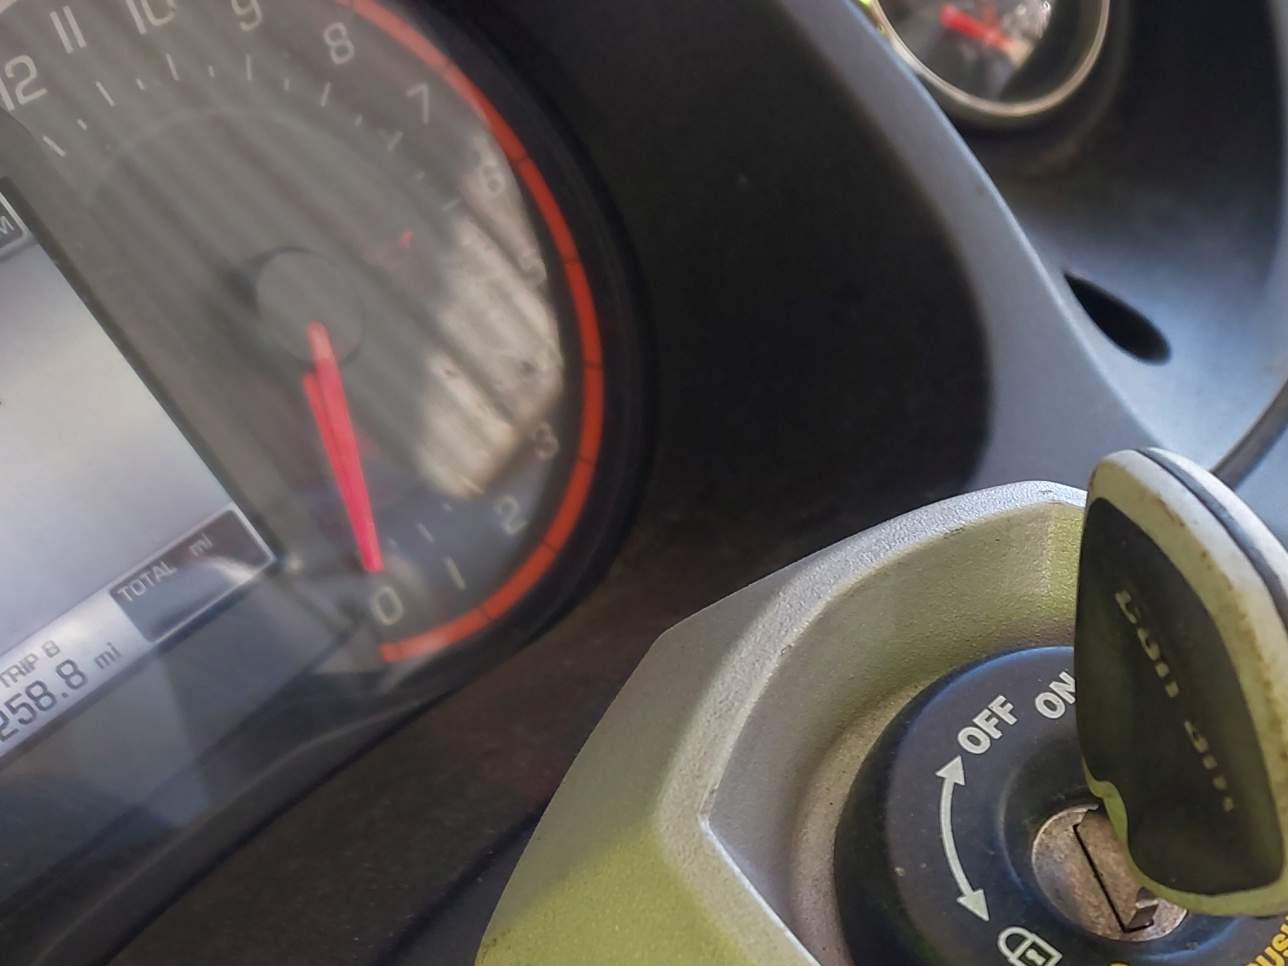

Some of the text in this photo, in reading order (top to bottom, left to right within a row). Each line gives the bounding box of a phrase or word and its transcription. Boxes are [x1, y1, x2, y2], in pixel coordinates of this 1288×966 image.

[50, 5, 87, 54] 11
[322, 21, 356, 65] 8
[405, 82, 431, 125] 7
[492, 495, 529, 536] 2
[117, 532, 214, 602] TOTAL mi
[370, 585, 404, 626] 0
[0, 652, 40, 690] TRIP
[93, 641, 122, 671] mi
[1034, 671, 1077, 720] ON
[957, 695, 1018, 755] OFF
